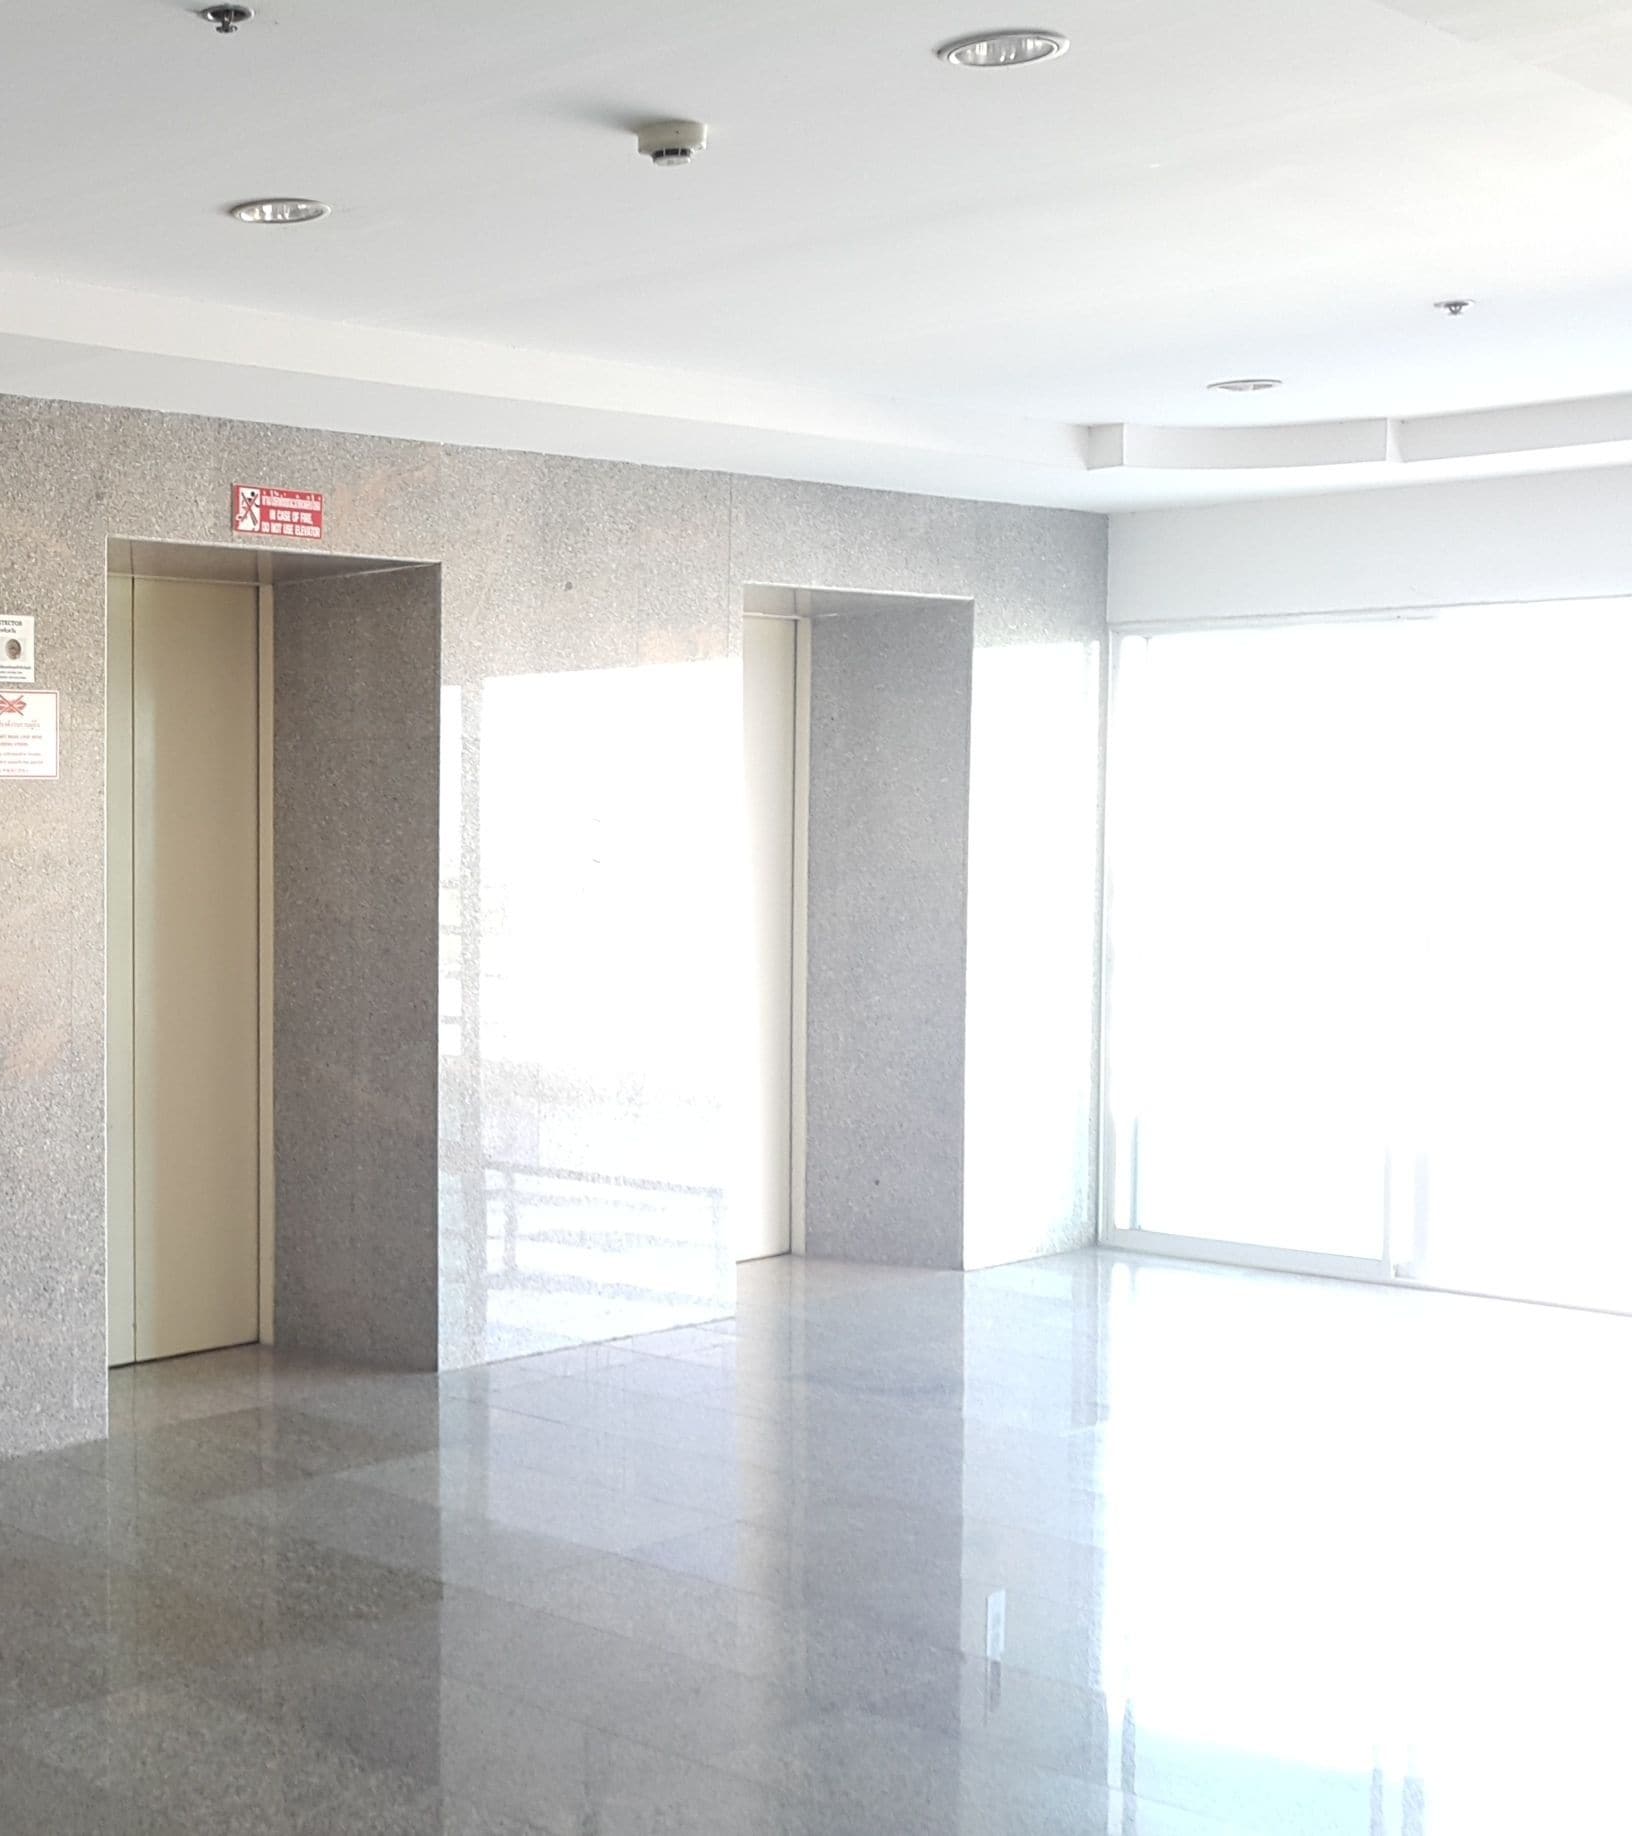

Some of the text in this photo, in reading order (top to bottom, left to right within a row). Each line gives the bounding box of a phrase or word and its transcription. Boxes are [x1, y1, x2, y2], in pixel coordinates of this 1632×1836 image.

[277, 510, 291, 522] CASE
[271, 522, 282, 534] NOT
[283, 523, 294, 535] USE
[295, 524, 321, 538] ELEVATOR
